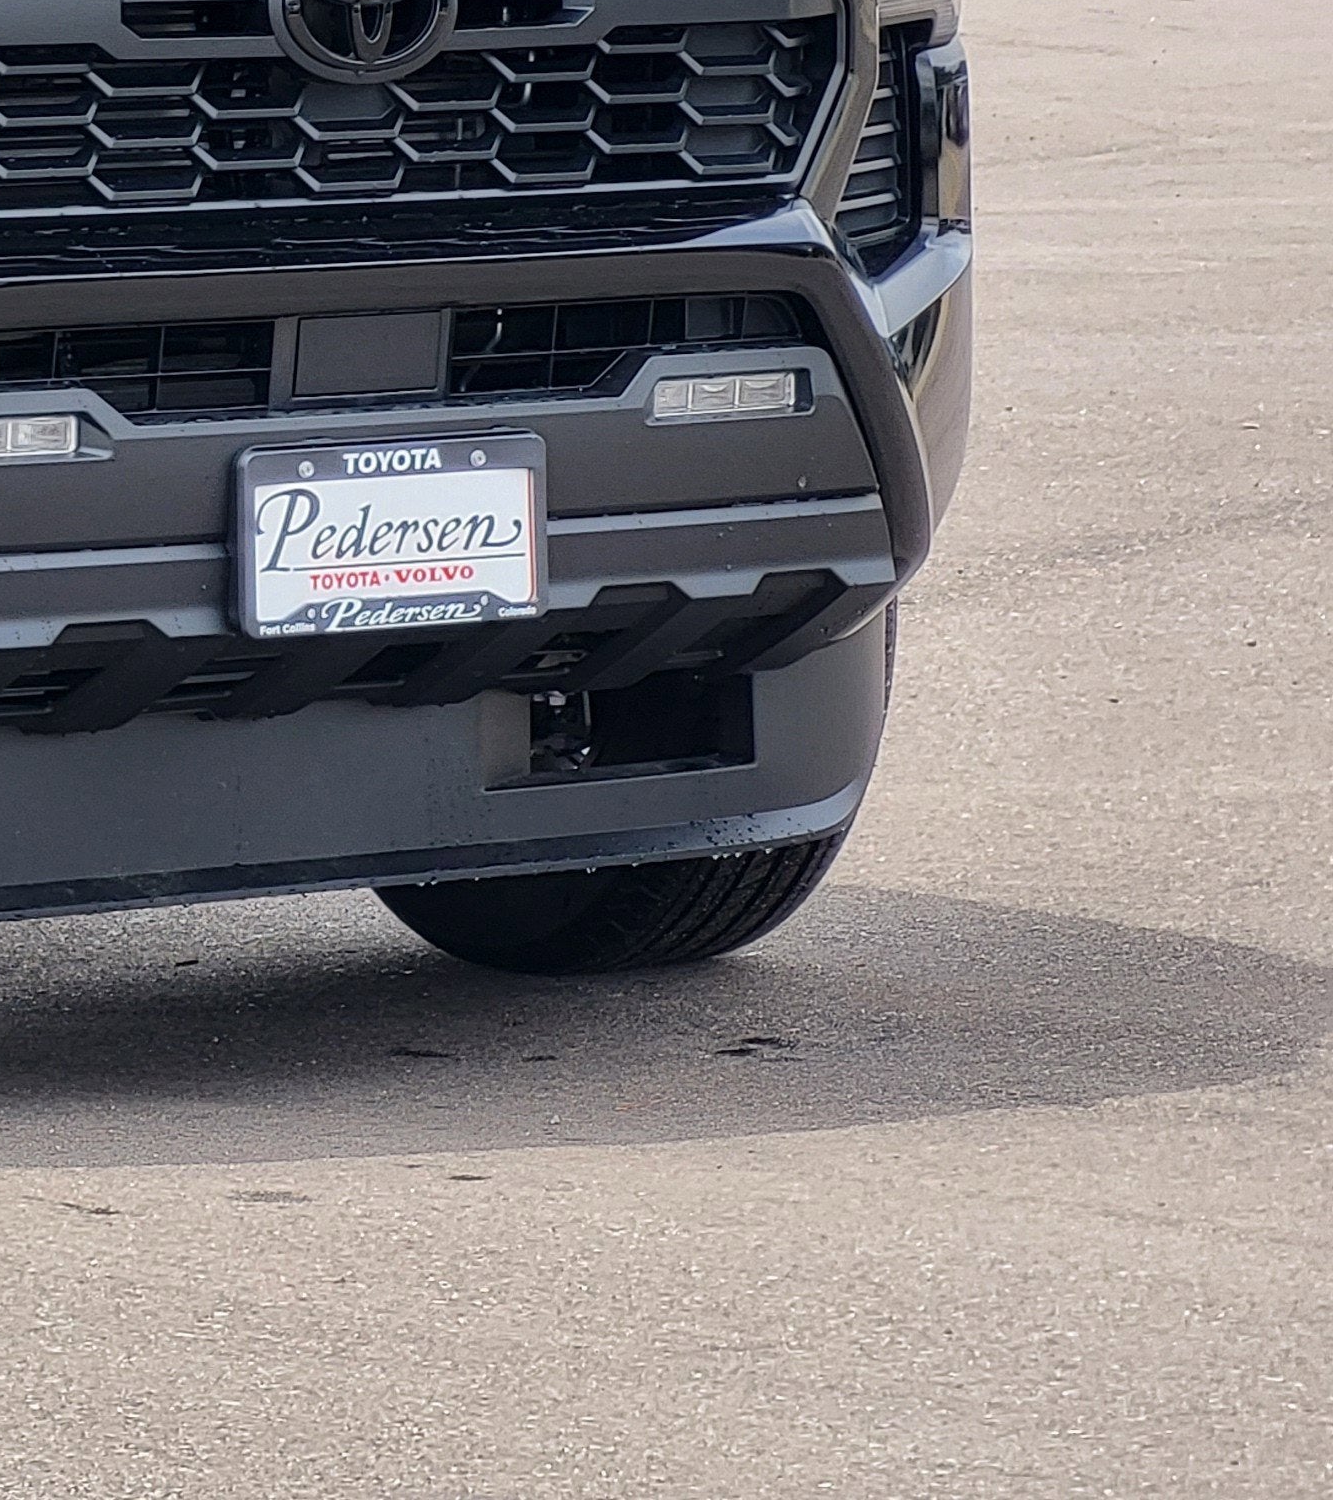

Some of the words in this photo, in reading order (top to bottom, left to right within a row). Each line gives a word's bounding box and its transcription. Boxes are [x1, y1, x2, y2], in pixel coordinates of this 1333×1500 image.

[342, 447, 442, 476] TOYOTA
[255, 487, 523, 574] Pedersen
[310, 570, 382, 591] TOYOTA
[394, 564, 475, 584] VOLVO
[259, 624, 280, 637] Fort
[282, 622, 316, 634] Collins
[320, 597, 483, 633] Pedersen
